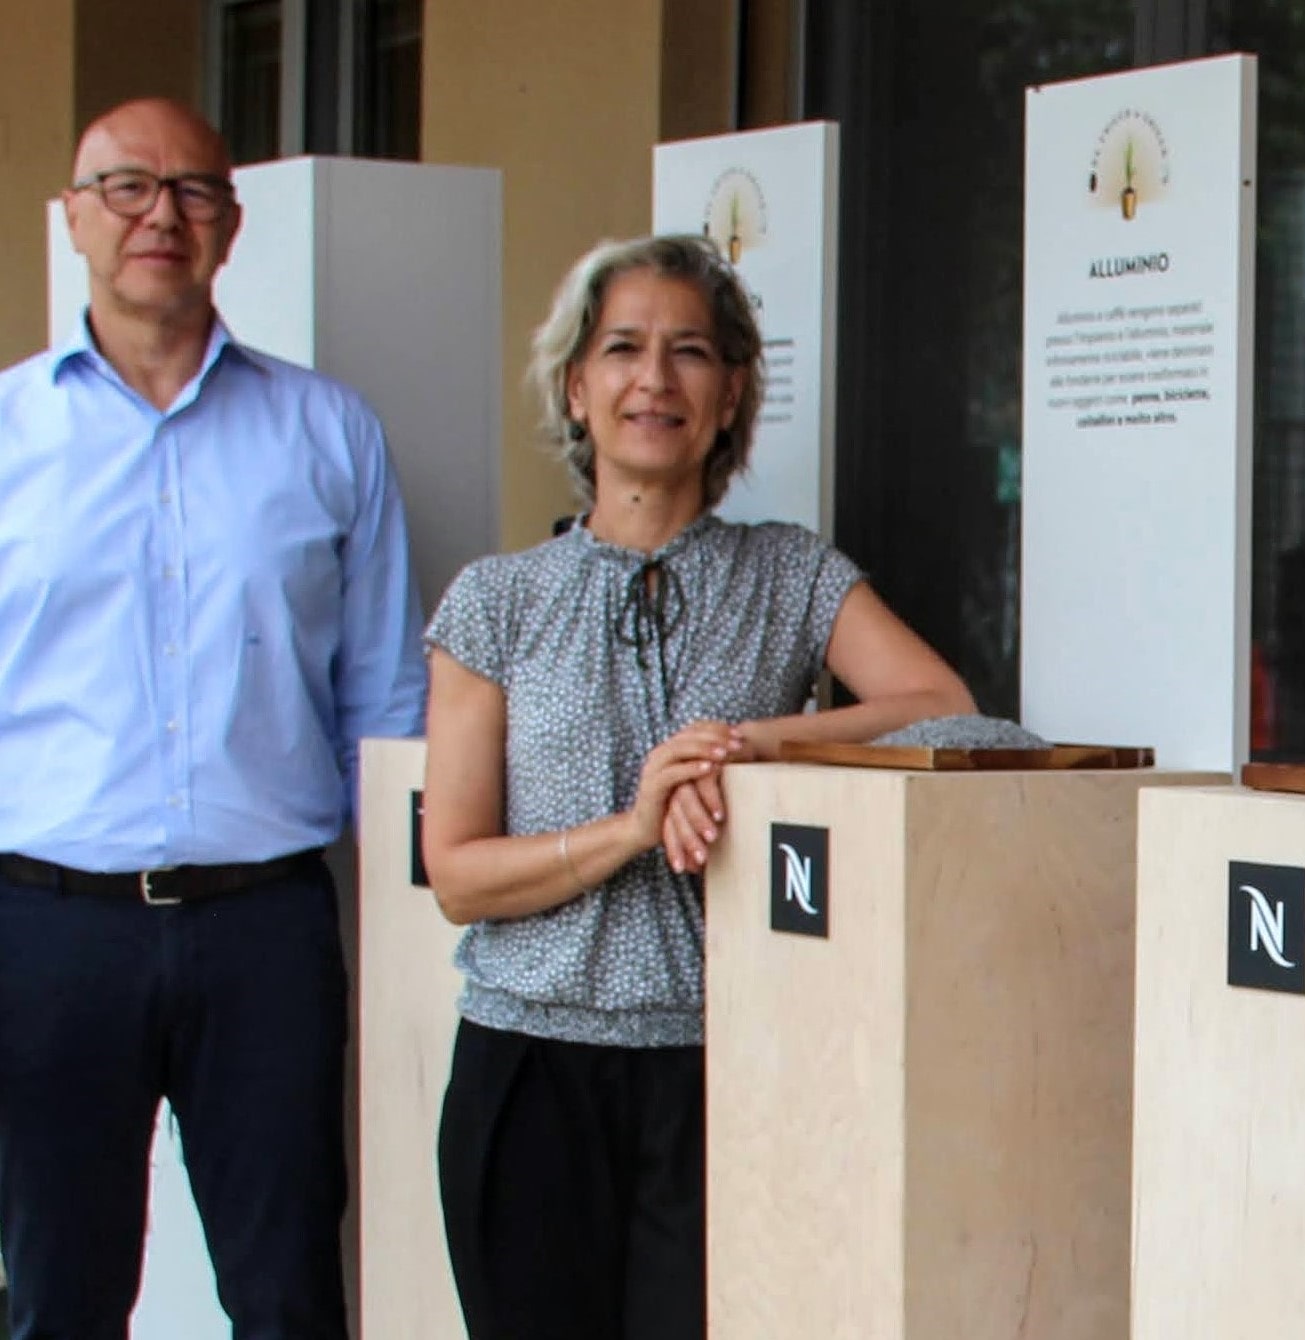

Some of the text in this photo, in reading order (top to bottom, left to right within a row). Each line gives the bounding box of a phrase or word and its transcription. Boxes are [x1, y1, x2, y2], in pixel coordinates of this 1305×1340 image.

[1089, 253, 1170, 279] ALLUMINIO
[778, 843, 818, 914] N
[1239, 885, 1296, 968] N
